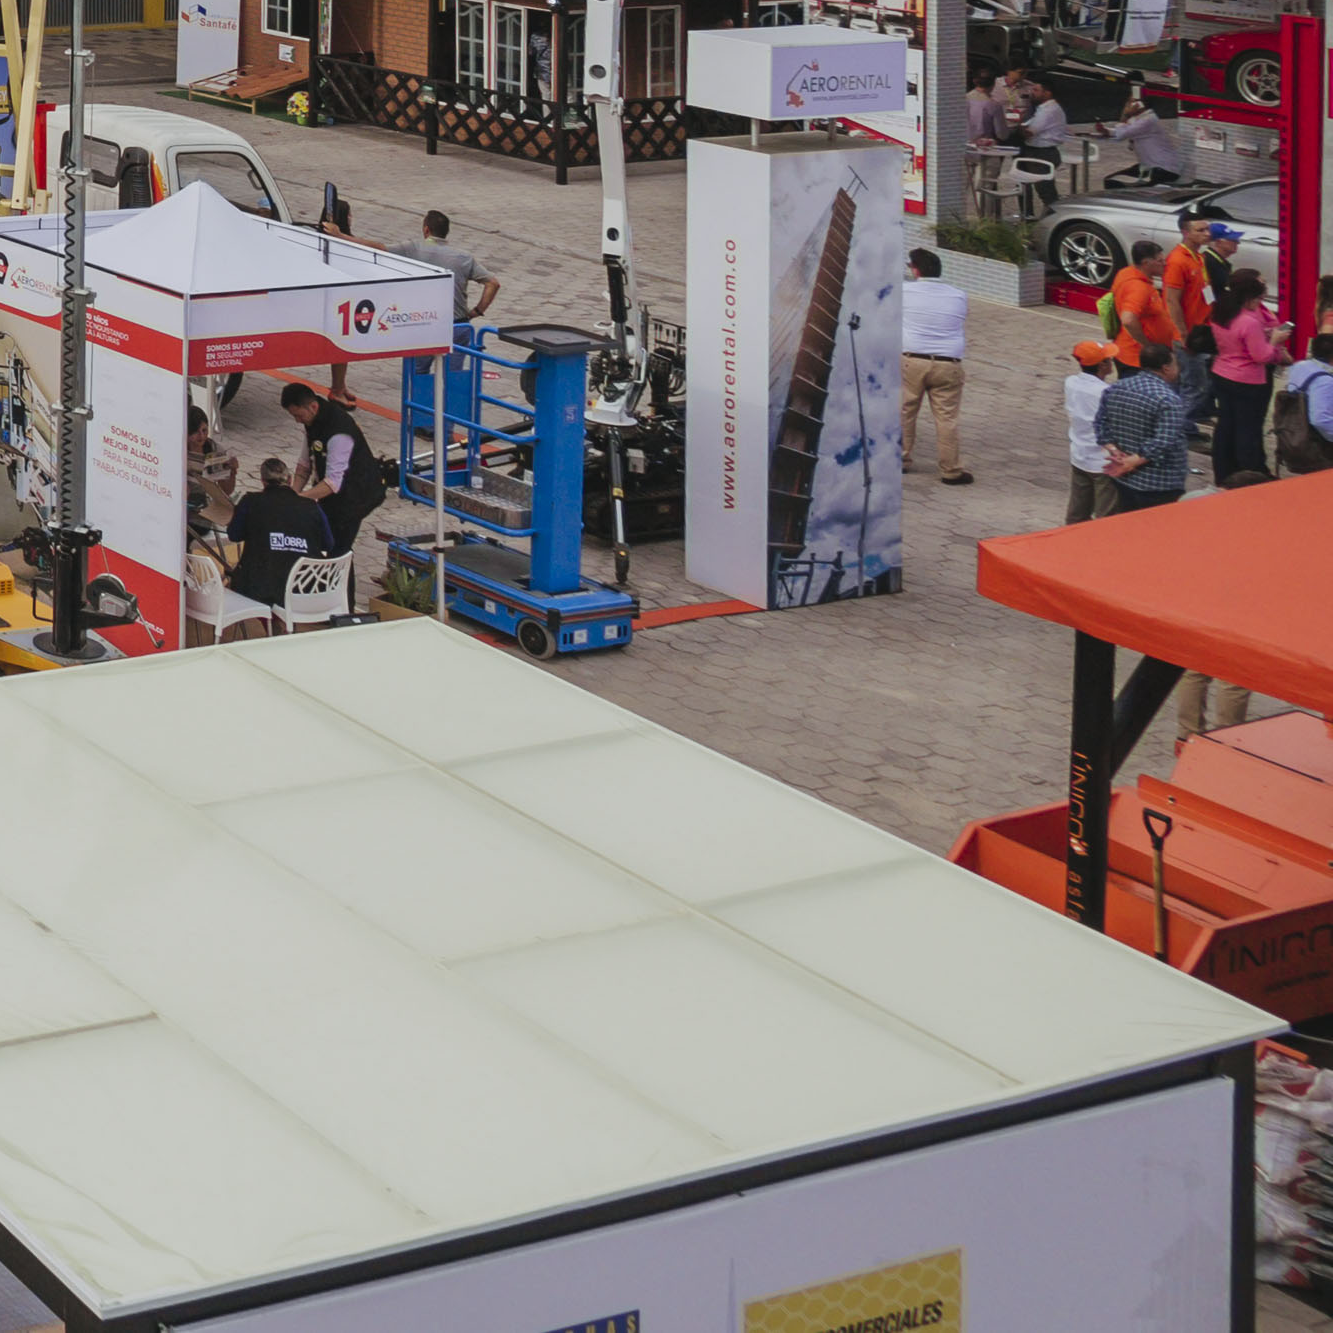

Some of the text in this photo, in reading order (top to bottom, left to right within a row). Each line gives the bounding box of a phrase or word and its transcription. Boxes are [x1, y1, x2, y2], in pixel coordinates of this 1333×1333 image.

[200, 17, 238, 31] Santafé
[799, 73, 892, 93] AERORENTAL
[385, 310, 438, 324] AERORENTAL
[206, 341, 264, 352] SOMOS SU SOCIO
[206, 349, 253, 360] EN SEGURIDAD
[206, 358, 243, 368] INDUSTRIAL
[722, 238, 737, 511] www.aerorental.com.co
[110, 425, 151, 448] SOMOS SU
[103, 435, 159, 465] MEJOR ALIADO
[103, 448, 159, 477] PARA REALIZAR
[92, 457, 172, 499] TRABAJOS EN ALTURA
[284, 536, 308, 549] OBRA
